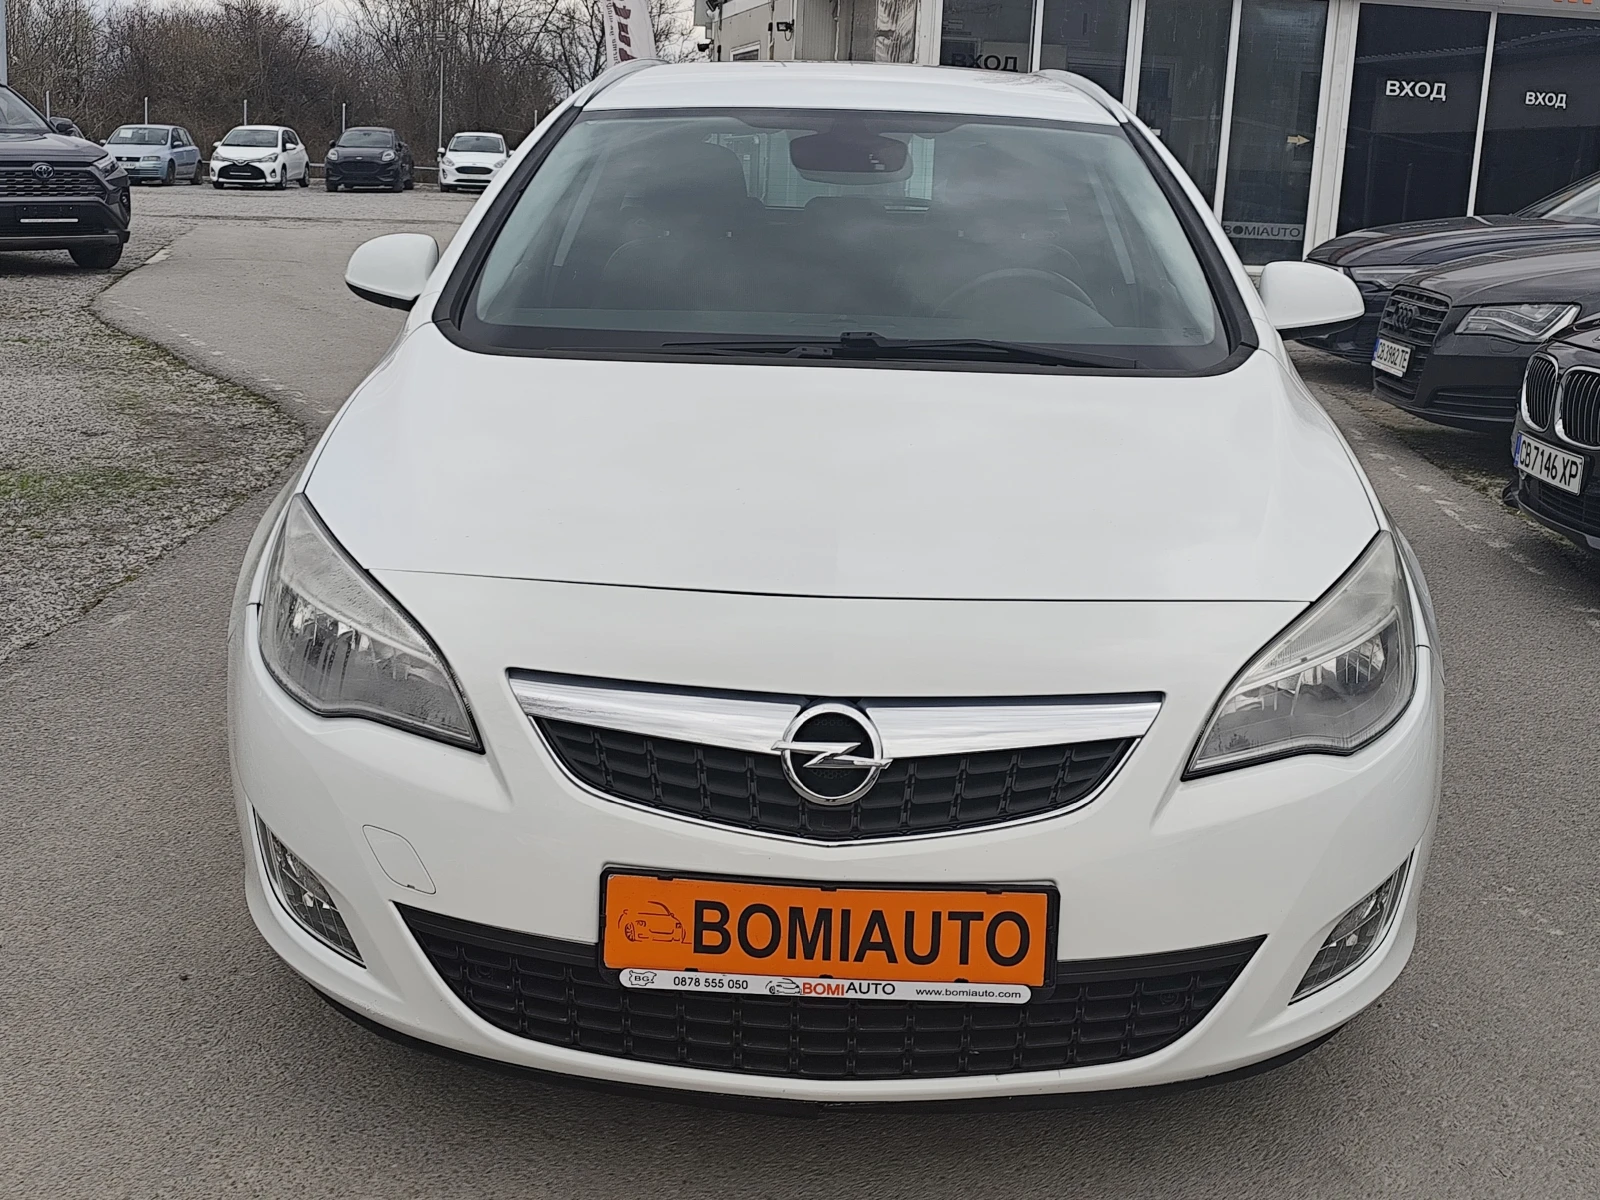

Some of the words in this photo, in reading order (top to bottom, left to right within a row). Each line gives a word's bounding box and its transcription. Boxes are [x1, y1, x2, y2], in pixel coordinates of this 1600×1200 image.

[1385, 80, 1447, 102] ВХОД
[1524, 91, 1567, 109] ВХОД
[692, 899, 1030, 967] BOMIAUTO
[673, 976, 701, 987] 0878
[704, 977, 724, 988] 555
[728, 979, 748, 990] 050
[915, 988, 1021, 999] www.bomiauto.com
